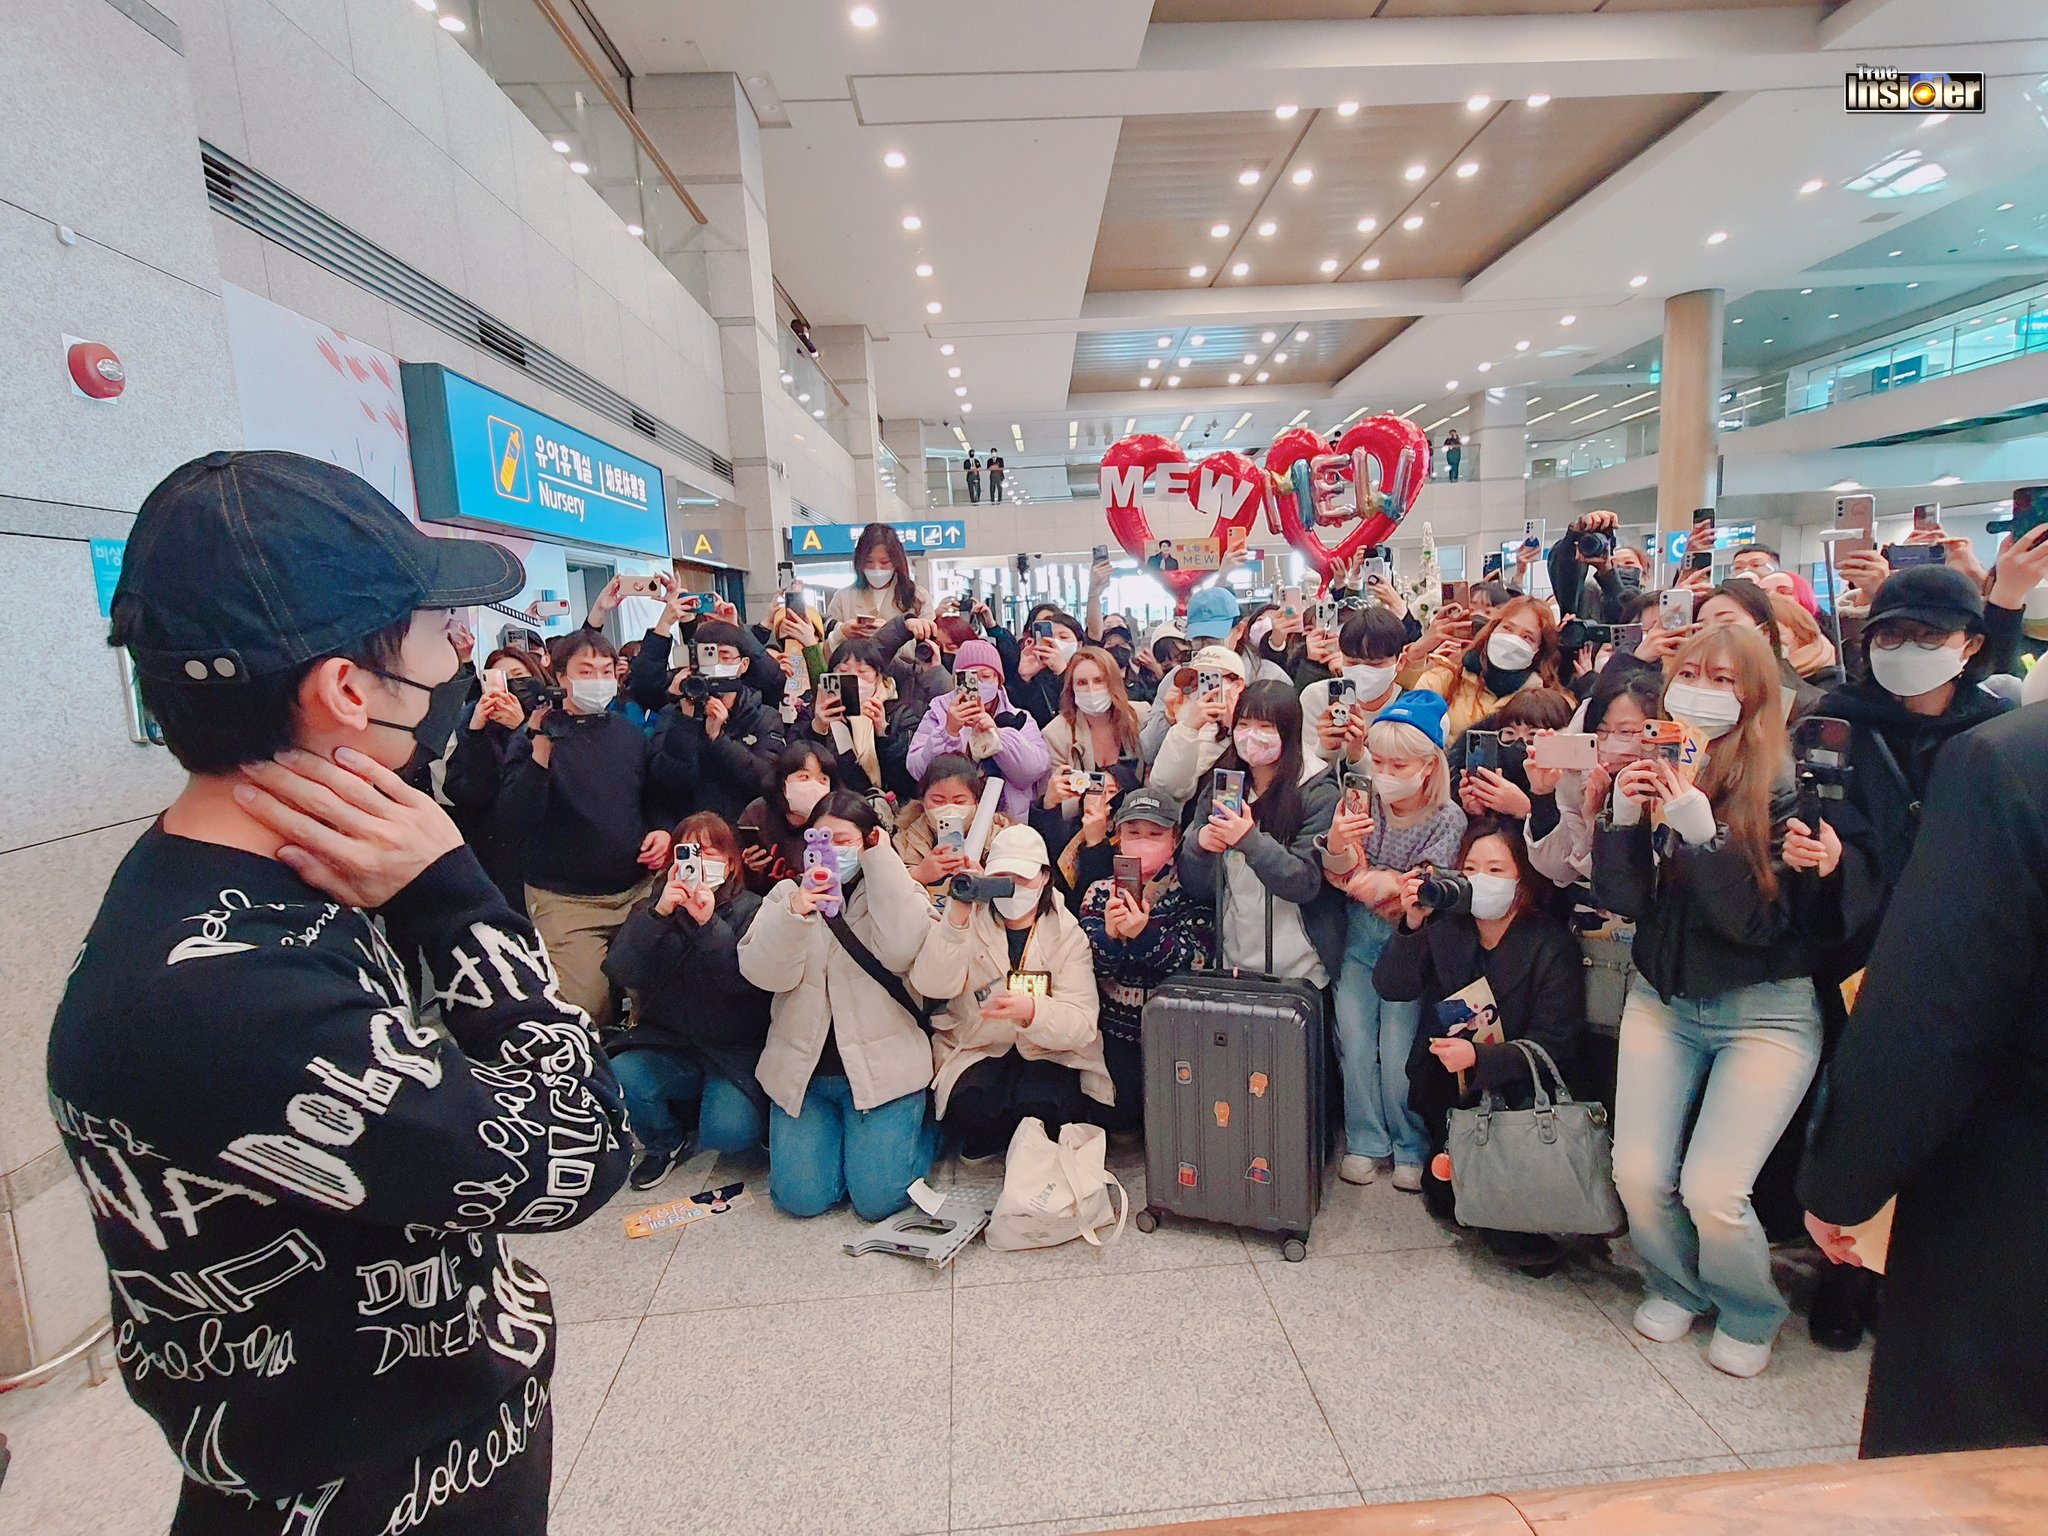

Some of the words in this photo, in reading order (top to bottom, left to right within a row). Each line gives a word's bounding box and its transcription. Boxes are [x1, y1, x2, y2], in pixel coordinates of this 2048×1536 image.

[535, 434, 593, 485] 유아휴게실
[538, 480, 585, 523] Nursery
[1101, 462, 1255, 520] MEW
[694, 533, 713, 555] A
[802, 529, 823, 550] A
[1183, 554, 1215, 565] MEW
